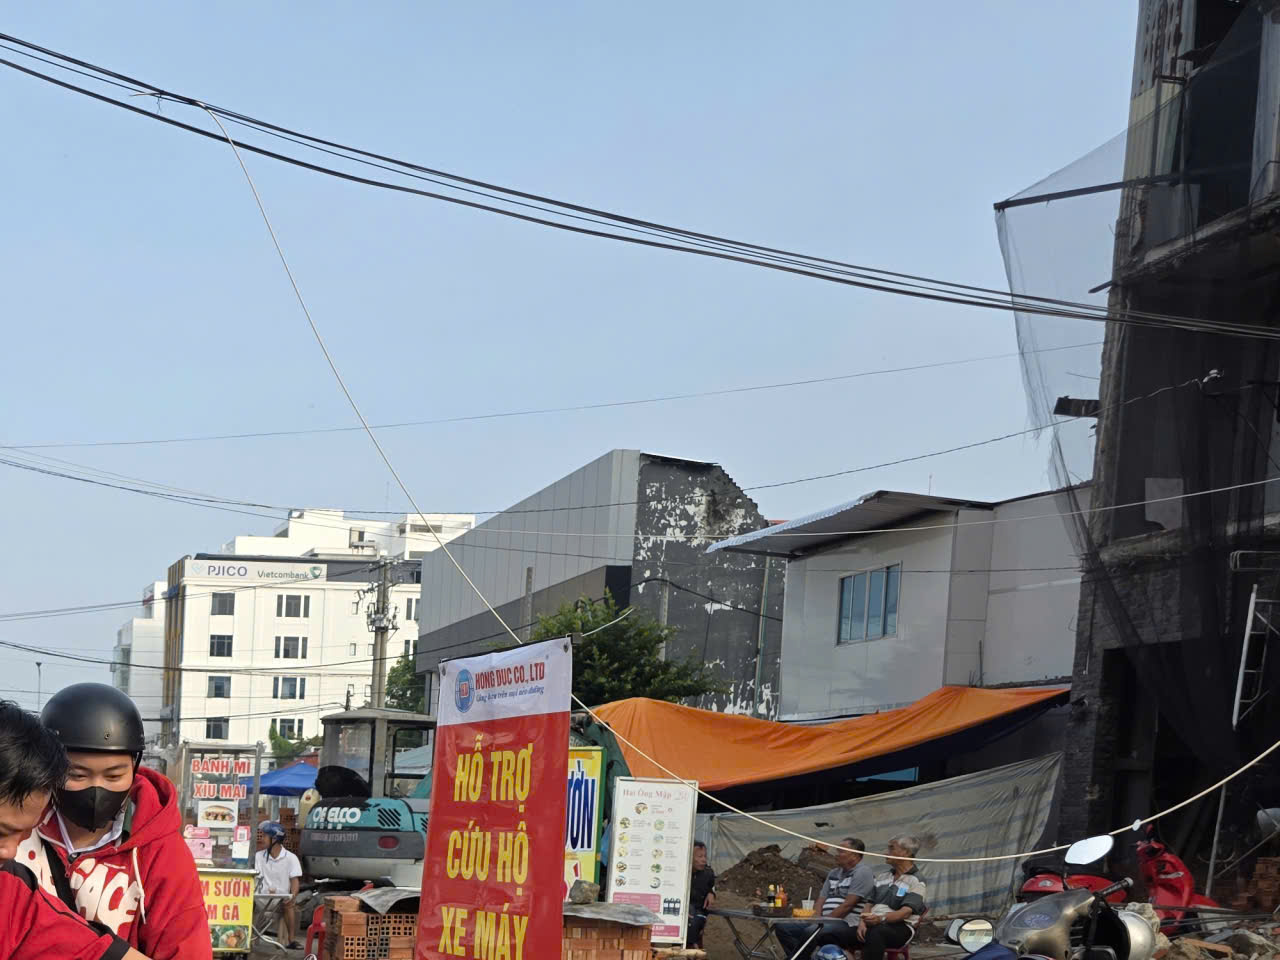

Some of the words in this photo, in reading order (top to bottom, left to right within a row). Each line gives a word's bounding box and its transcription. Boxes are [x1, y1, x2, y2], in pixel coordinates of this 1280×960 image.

[207, 565, 248, 577] PJICO
[257, 570, 309, 579] Vietcombank
[530, 662, 545, 681] LTD
[191, 757, 230, 774] BÁNH
[453, 732, 484, 802] HỖ
[490, 743, 534, 813] TRỢ
[193, 781, 217, 798] XÍU
[446, 819, 491, 881] CỨU
[496, 820, 529, 896] HỘ
[438, 905, 468, 957] XE
